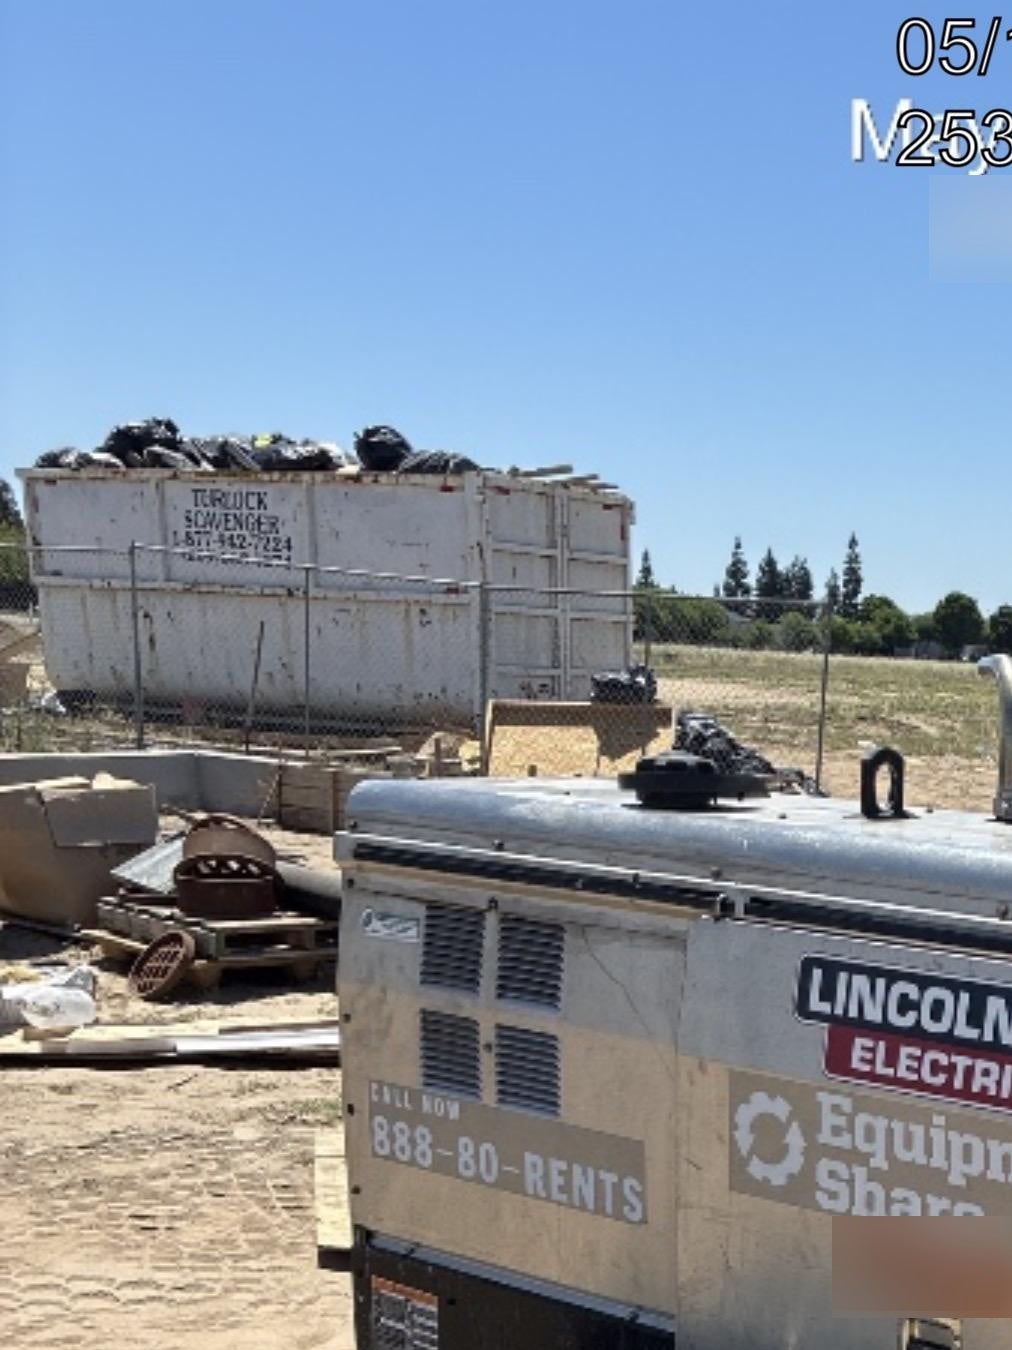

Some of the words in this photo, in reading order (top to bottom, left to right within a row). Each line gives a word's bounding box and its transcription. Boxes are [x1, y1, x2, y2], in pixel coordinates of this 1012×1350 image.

[191, 489, 269, 511] TURLOCK
[184, 509, 280, 535] SCAVENGER
[370, 1082, 413, 1111] CALL
[422, 1094, 461, 1121] NOW
[371, 1114, 644, 1223] 888-80-RENTS
